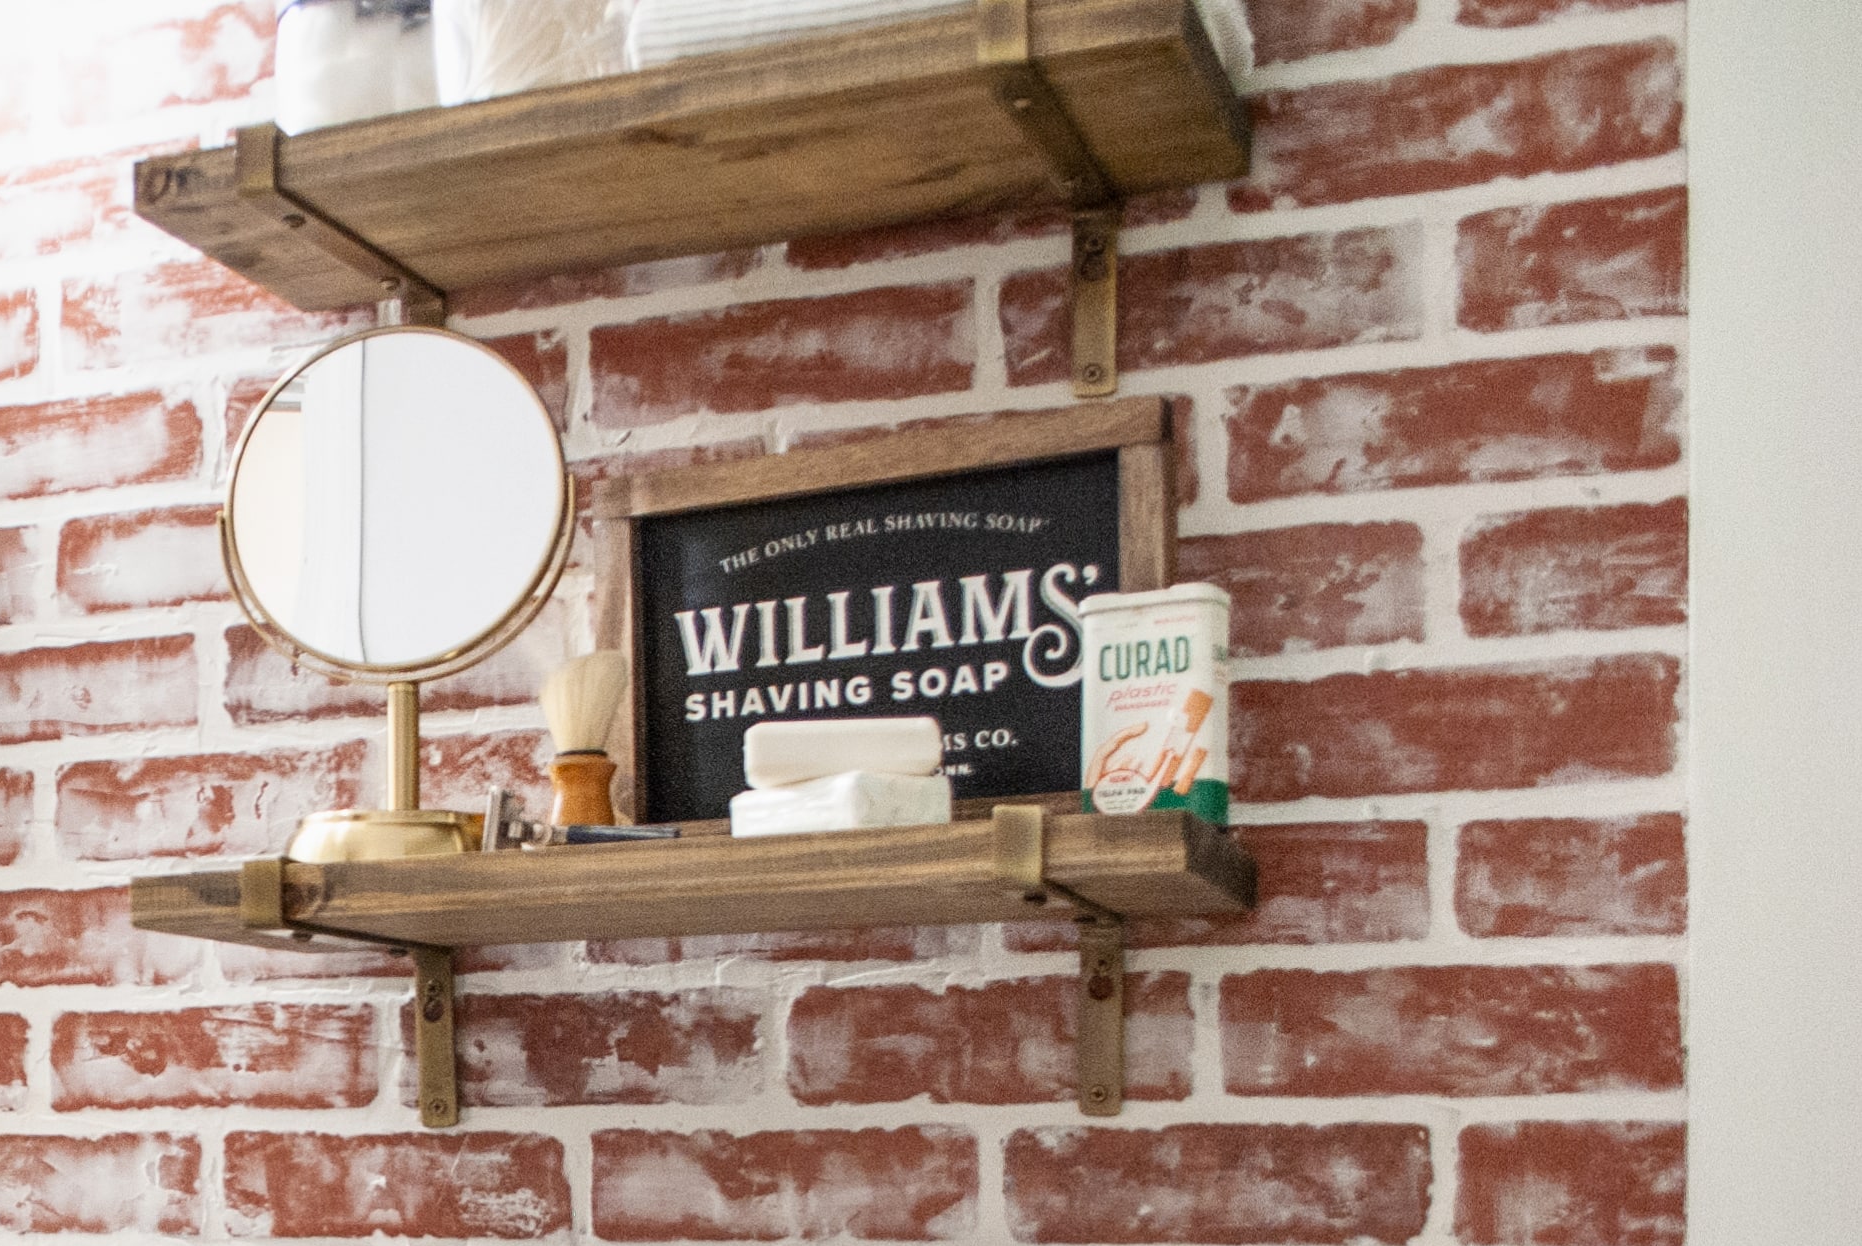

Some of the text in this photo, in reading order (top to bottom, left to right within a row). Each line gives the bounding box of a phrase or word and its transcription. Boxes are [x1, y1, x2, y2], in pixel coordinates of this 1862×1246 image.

[719, 547, 760, 574] THE
[764, 528, 819, 558] ONLY
[825, 517, 878, 541] REAL
[885, 512, 978, 532] SHAVING
[1100, 635, 1190, 682] CURAD
[684, 661, 1009, 722] SHAVING SOAP
[1106, 683, 1178, 708] plastic
[974, 728, 1018, 749] CO.
